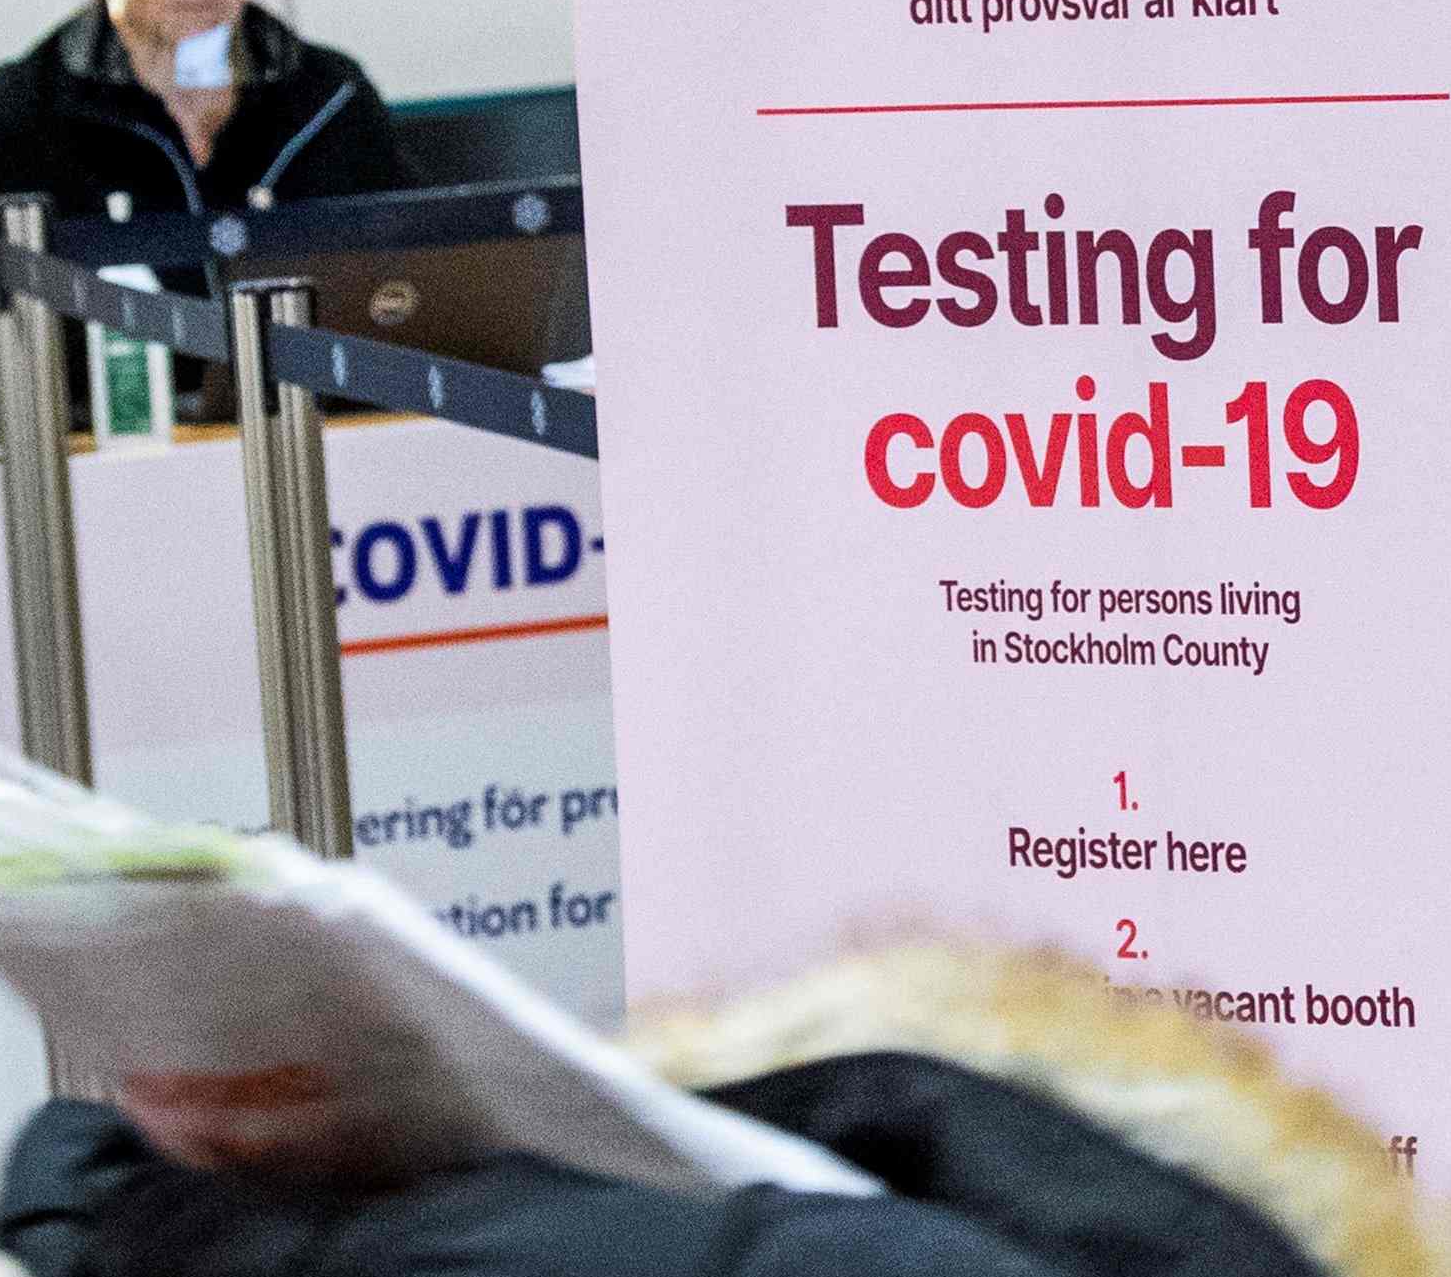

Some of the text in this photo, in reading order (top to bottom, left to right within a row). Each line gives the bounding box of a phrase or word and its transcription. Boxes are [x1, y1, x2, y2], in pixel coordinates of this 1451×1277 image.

[786, 191, 1423, 361] Testing for
[865, 375, 1359, 509] covid-19
[939, 580, 1300, 624] Testing for persons living
[973, 630, 1269, 676] in Stockholm County
[484, 784, 547, 830] för
[1114, 771, 1138, 810] 1.
[1009, 827, 1246, 879] Register here
[550, 882, 615, 929] for
[1117, 919, 1148, 959] 2.
[1306, 984, 1415, 1027] booth
